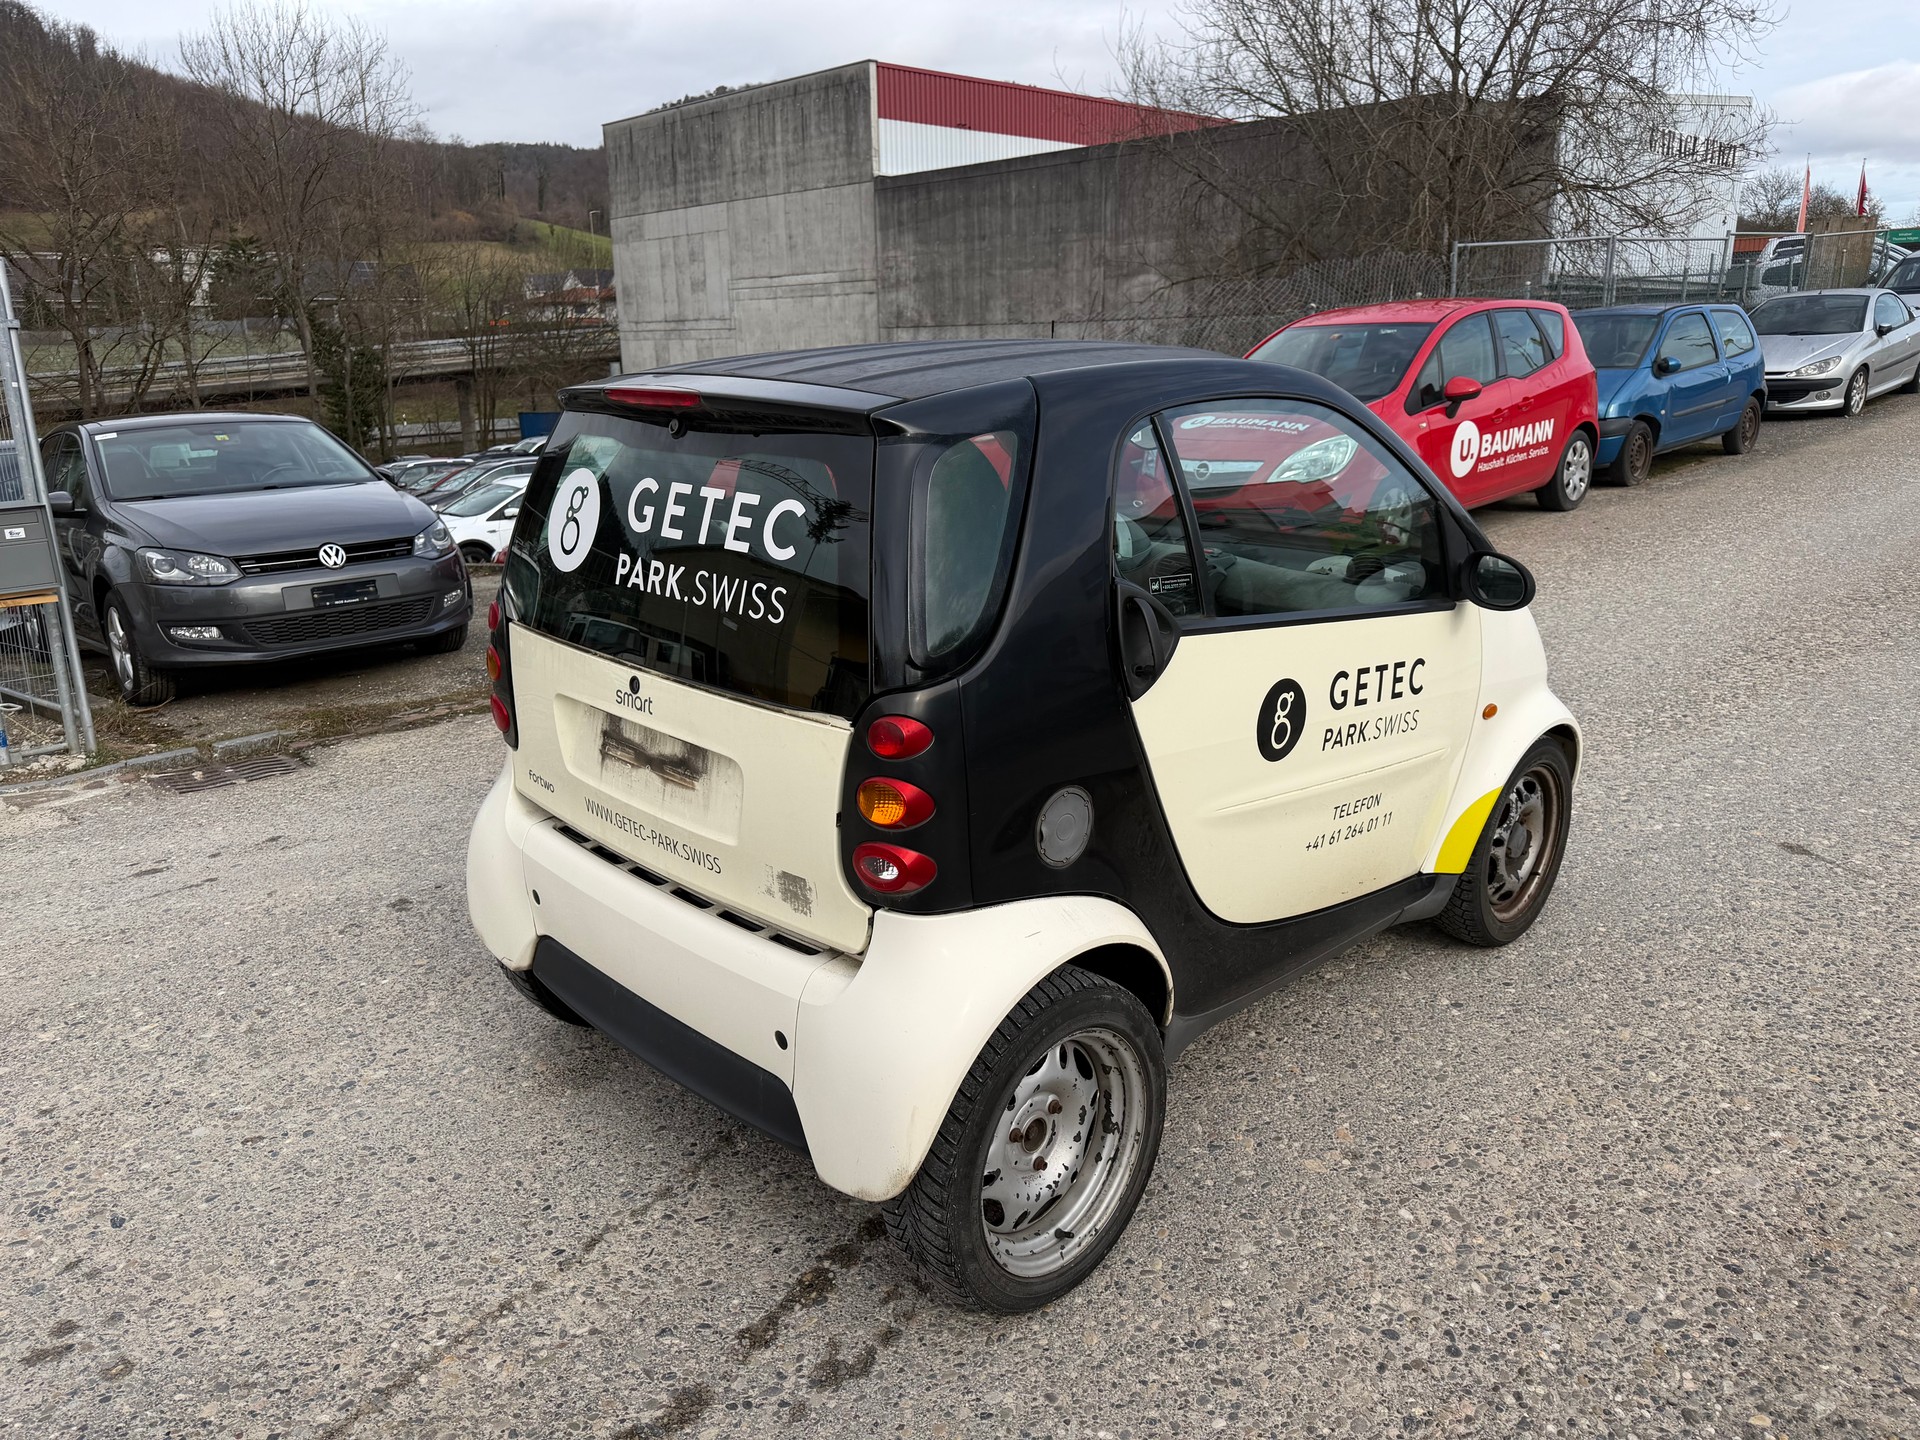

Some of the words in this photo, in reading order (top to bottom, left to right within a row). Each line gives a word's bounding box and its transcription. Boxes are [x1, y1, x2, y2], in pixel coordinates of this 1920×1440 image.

[1210, 418, 1310, 431] BAUMANN
[1480, 418, 1554, 458] BAUMANN
[1477, 456, 1505, 472] Haushalt.
[1505, 452, 1528, 465] Küchen.
[1528, 447, 1549, 459] Service.
[627, 477, 807, 562] GETEC
[614, 552, 788, 625] PARK.SWISS
[615, 687, 653, 716] smart
[1329, 656, 1427, 711] GETEC
[1321, 709, 1420, 751] PARK.SWISS
[1332, 791, 1382, 821] TELEFON
[583, 796, 723, 875] WWW.GETEC-PARK.SWISS
[1305, 834, 1325, 852] +41
[1329, 827, 1343, 844] 61
[1344, 821, 1364, 841] 264
[1366, 816, 1380, 834] 01
[1382, 811, 1393, 828] 11
